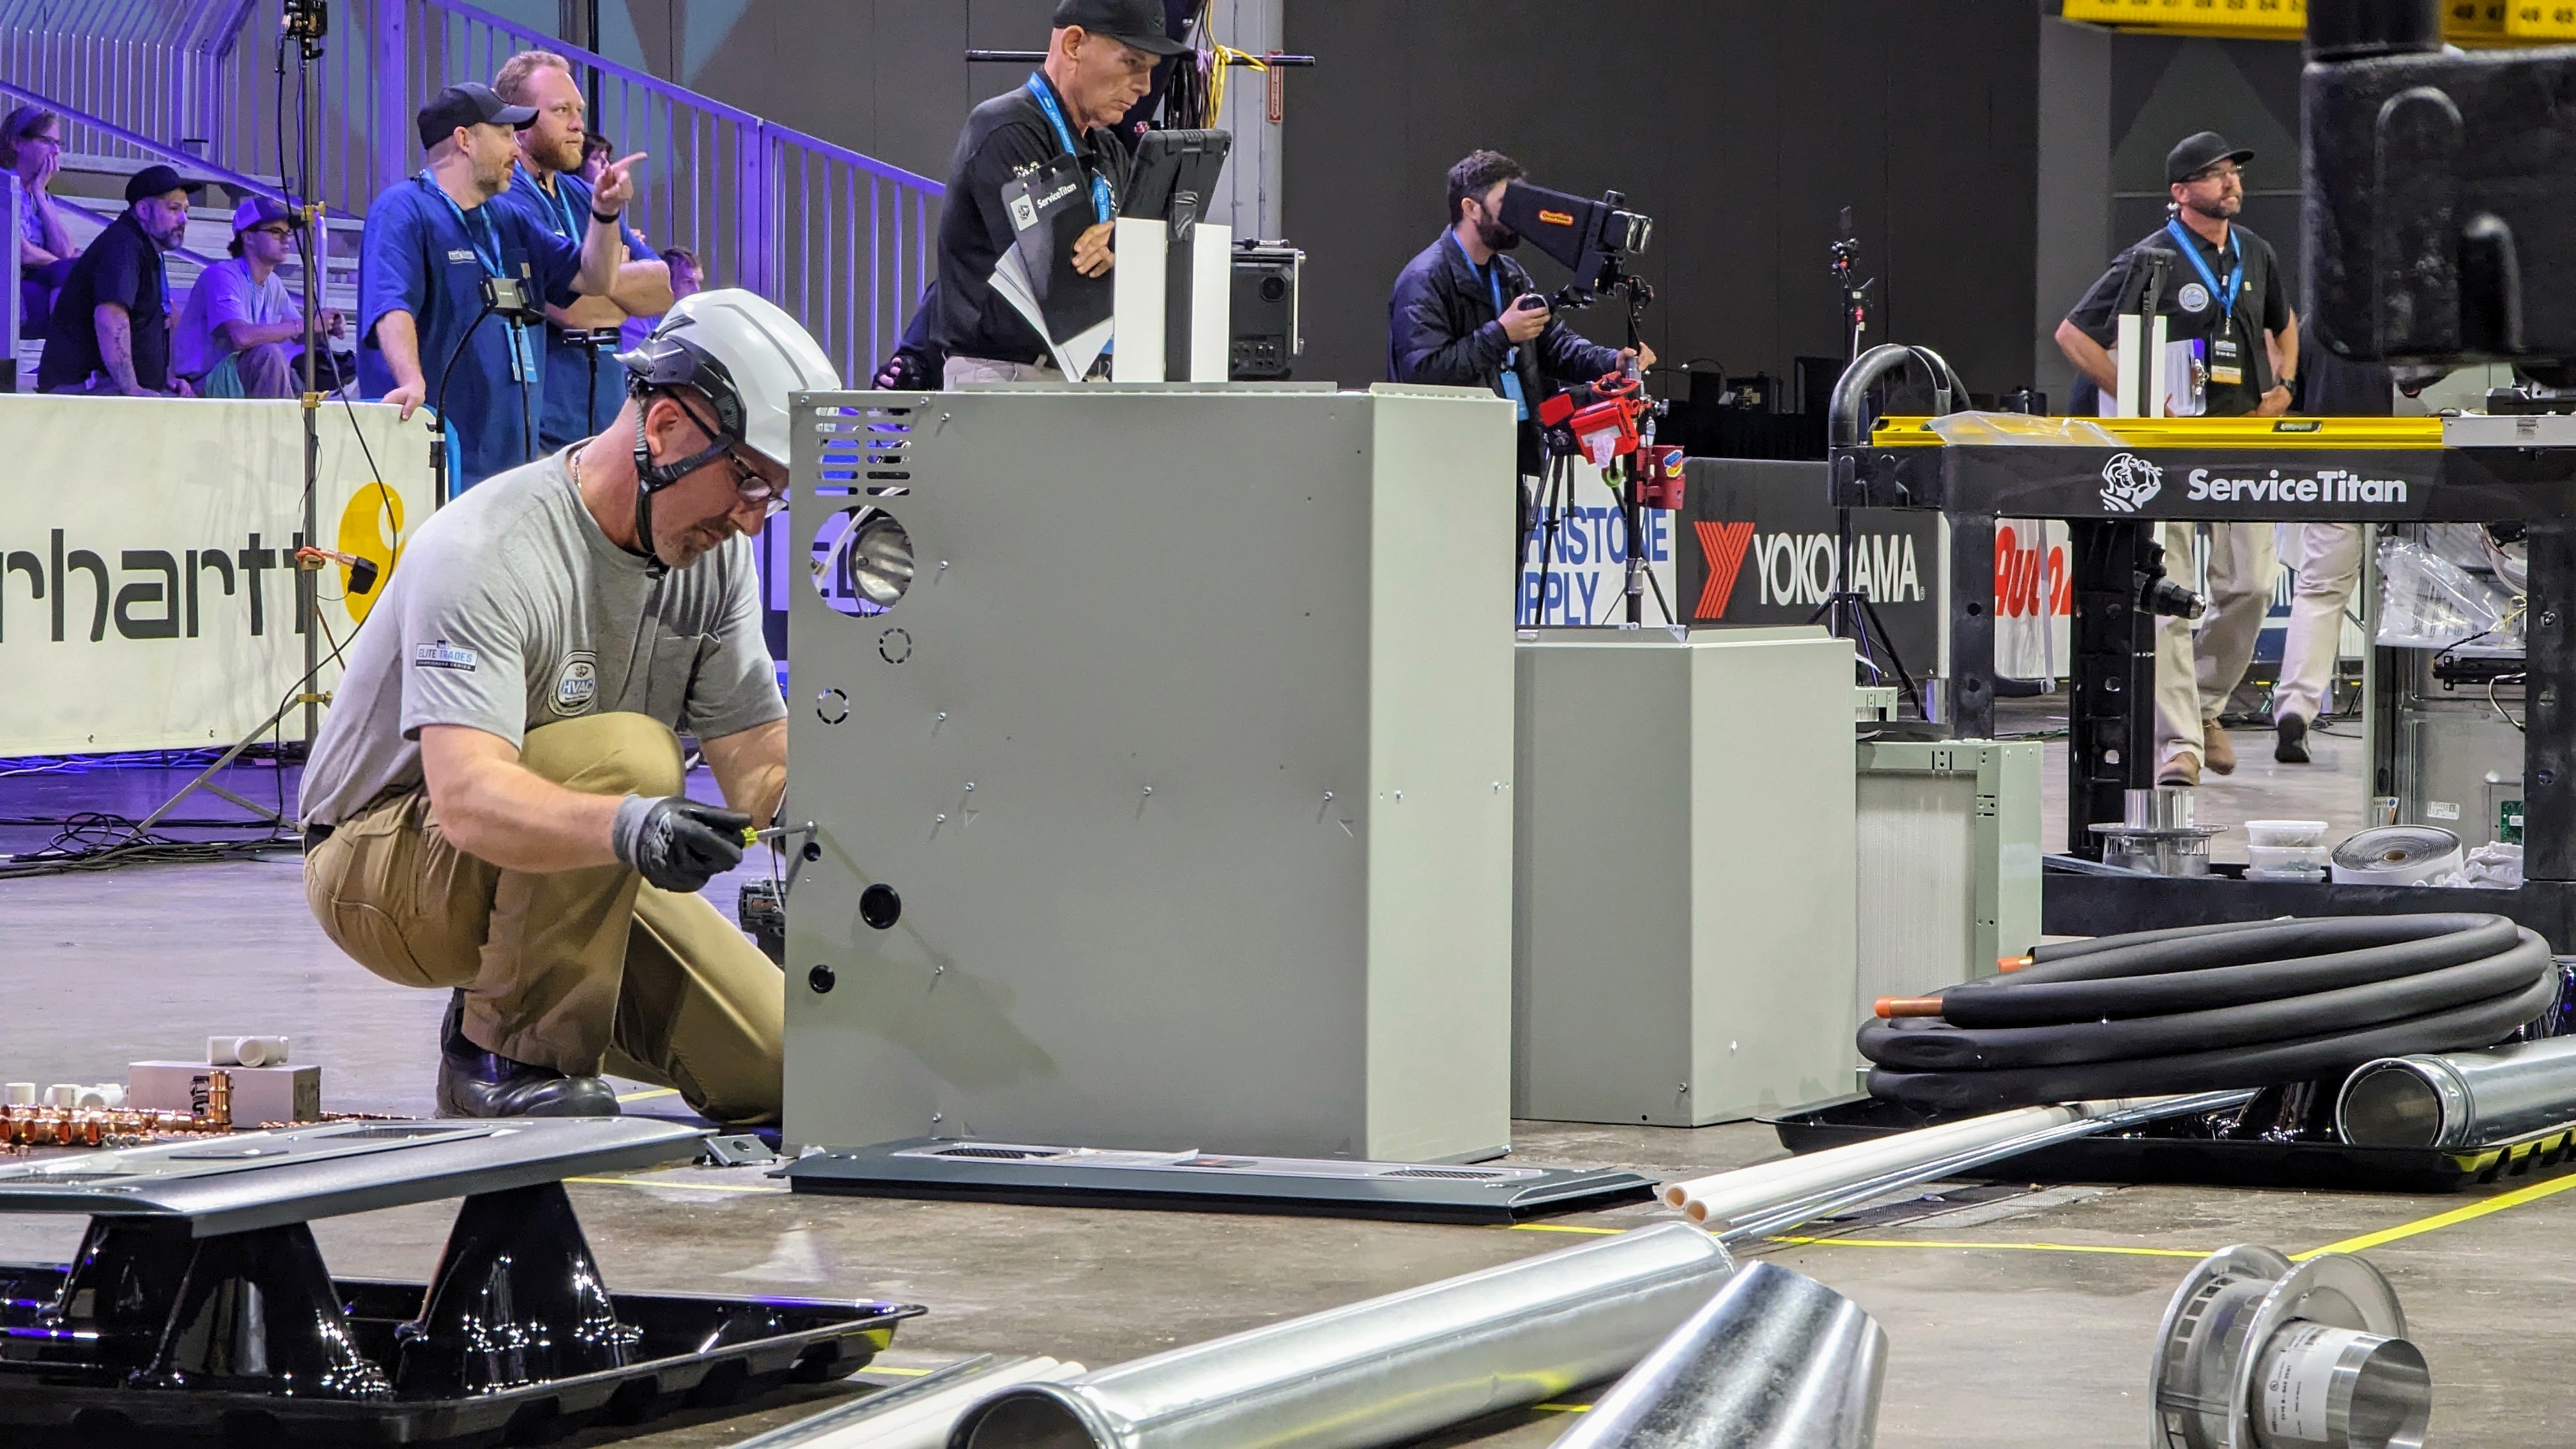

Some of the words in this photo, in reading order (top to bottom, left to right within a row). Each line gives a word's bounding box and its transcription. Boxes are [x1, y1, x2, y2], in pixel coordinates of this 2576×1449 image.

[1036, 183, 1077, 209] ServiceTitan
[2187, 468, 2407, 503] ServiceTitan
[418, 648, 437, 659] ELITE
[440, 649, 473, 663] TRADES
[562, 678, 594, 694] HVAC
